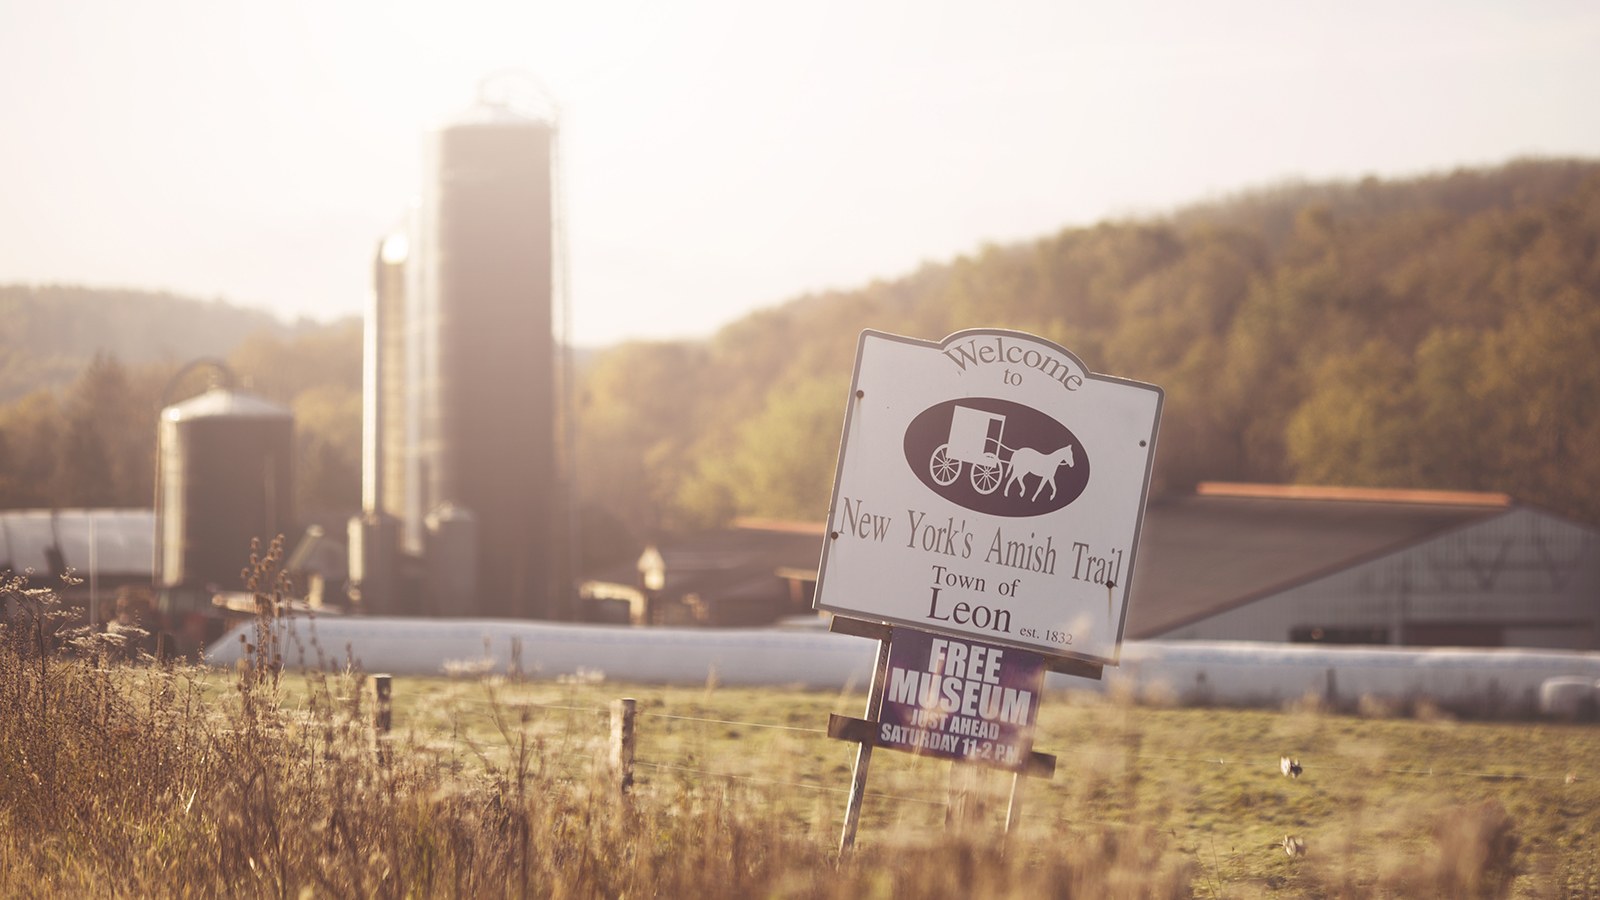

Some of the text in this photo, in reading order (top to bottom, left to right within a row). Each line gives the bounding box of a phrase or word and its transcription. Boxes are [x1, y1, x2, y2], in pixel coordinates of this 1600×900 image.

[943, 337, 1083, 392] Welcome
[1003, 368, 1023, 387] to
[838, 497, 1123, 588] New York's Amish Trail
[932, 565, 1021, 599] Town of
[926, 587, 1012, 634] Leon
[1019, 627, 1073, 645] est. 1832
[928, 638, 1003, 685] FREE
[888, 667, 1031, 726] MUSEUM
[881, 723, 960, 753] SATURDAY
[961, 738, 993, 759] 11-2
[910, 708, 1000, 740] JUST AHEAD
